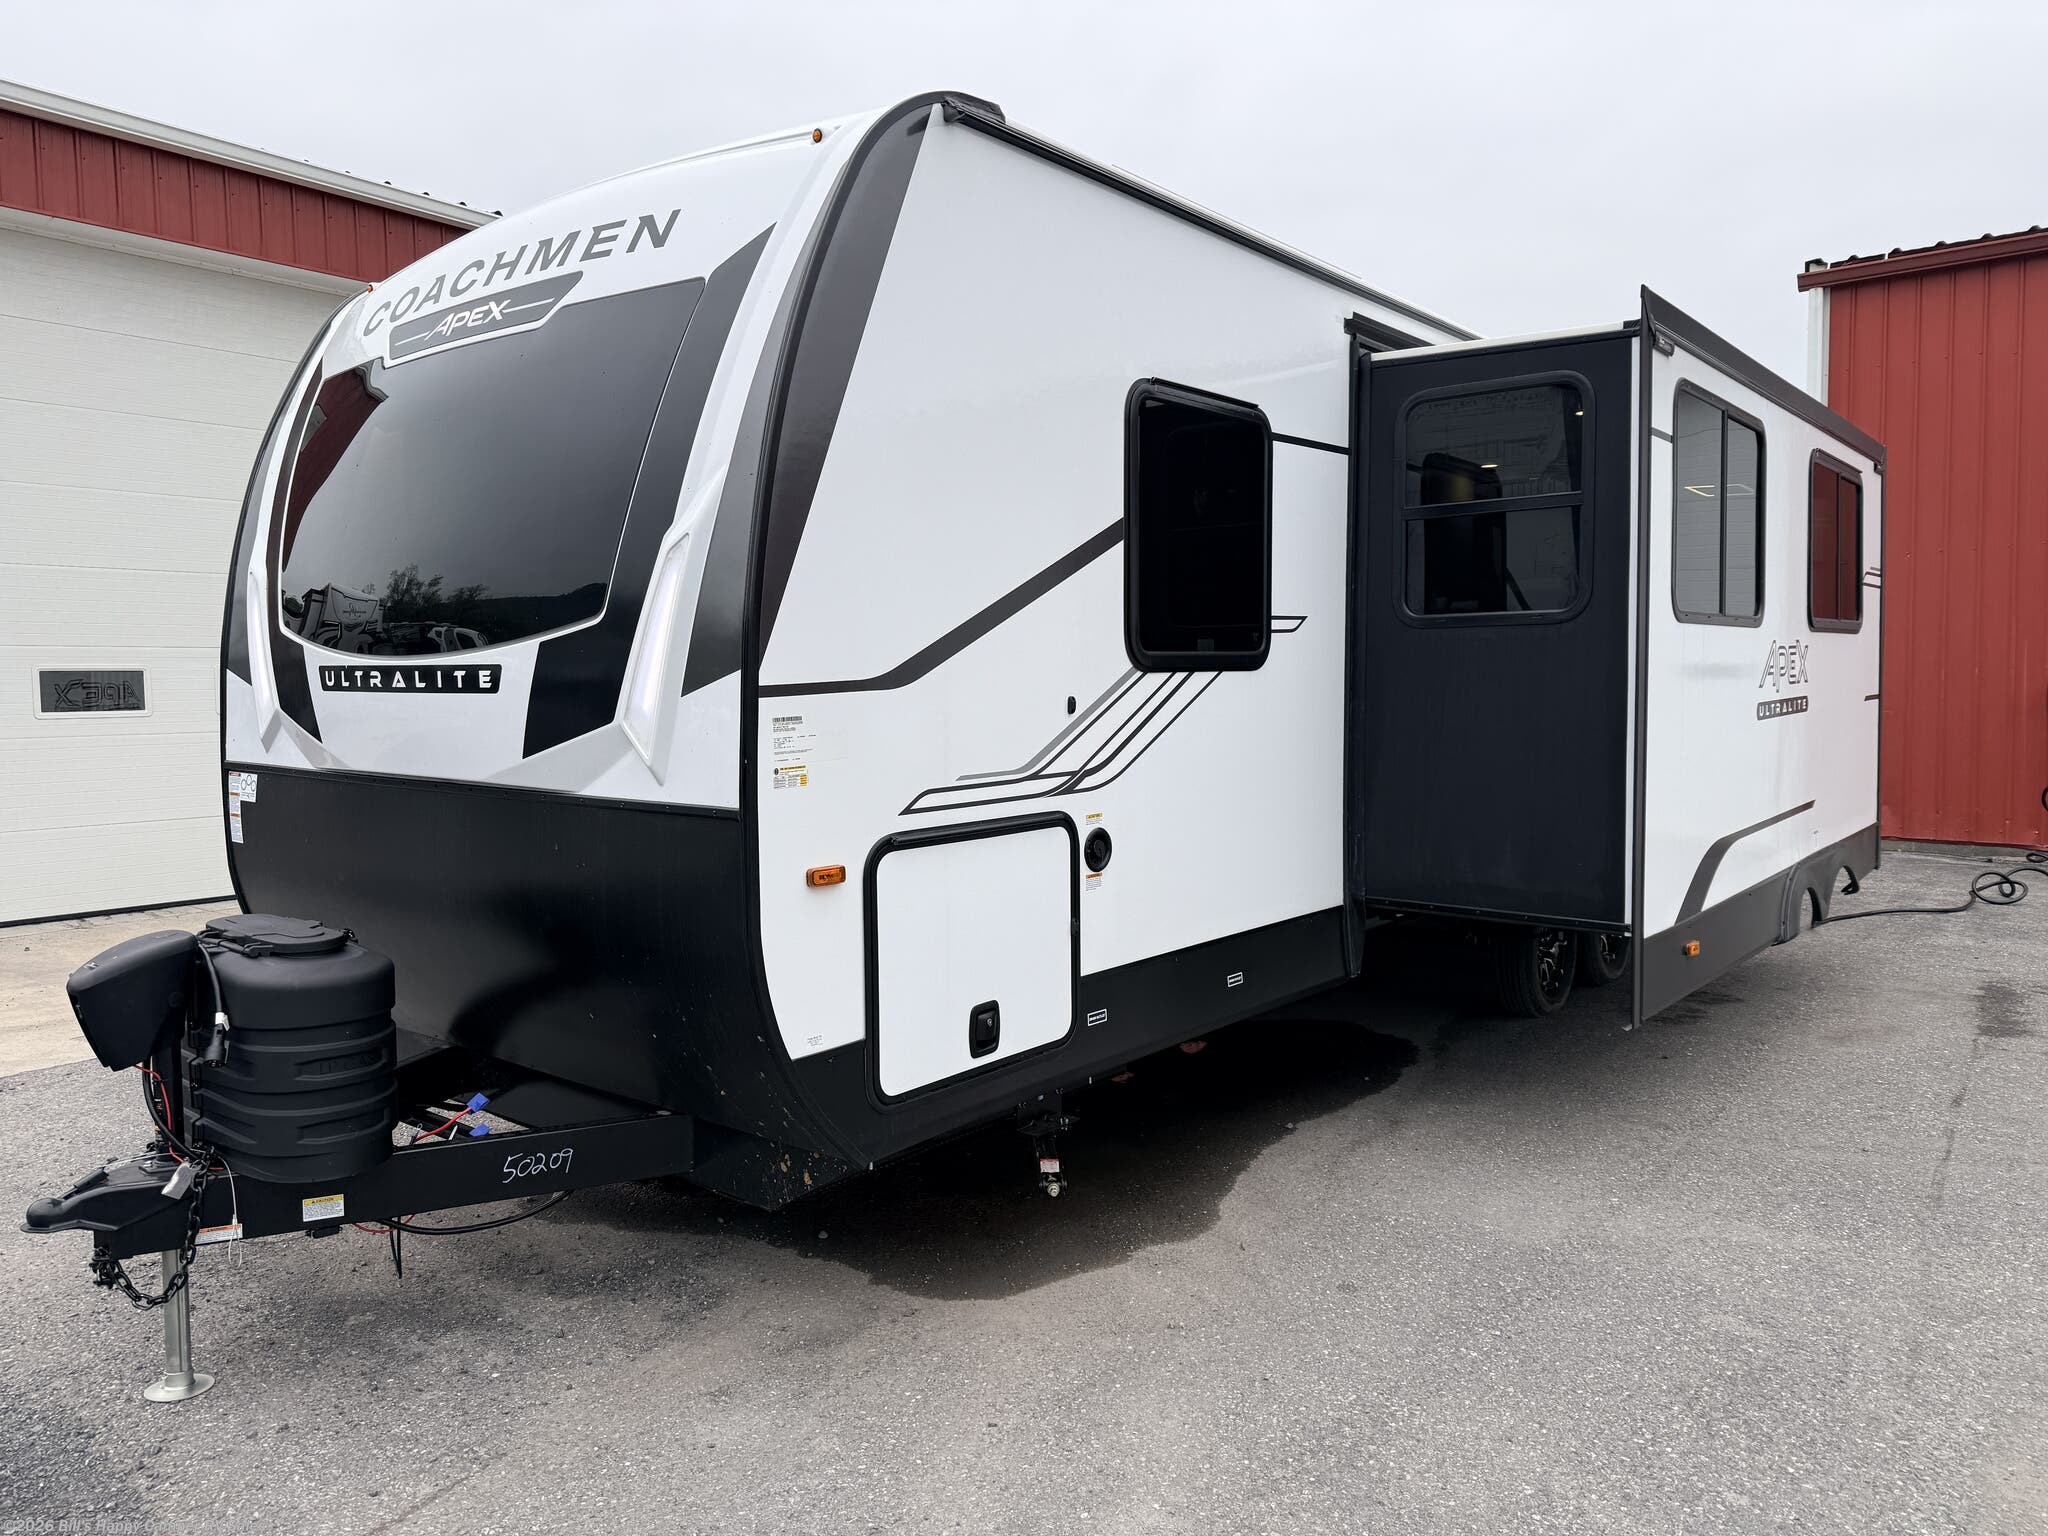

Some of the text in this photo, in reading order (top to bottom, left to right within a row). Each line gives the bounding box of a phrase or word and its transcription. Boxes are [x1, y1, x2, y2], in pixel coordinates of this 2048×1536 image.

[363, 208, 682, 337] COACHMEN
[424, 300, 511, 341] APEX
[325, 670, 493, 689] ULTRALITE
[1758, 639, 1808, 693] APEX
[1759, 698, 1808, 717] ULTRALITE
[502, 1148, 574, 1183] 50209
